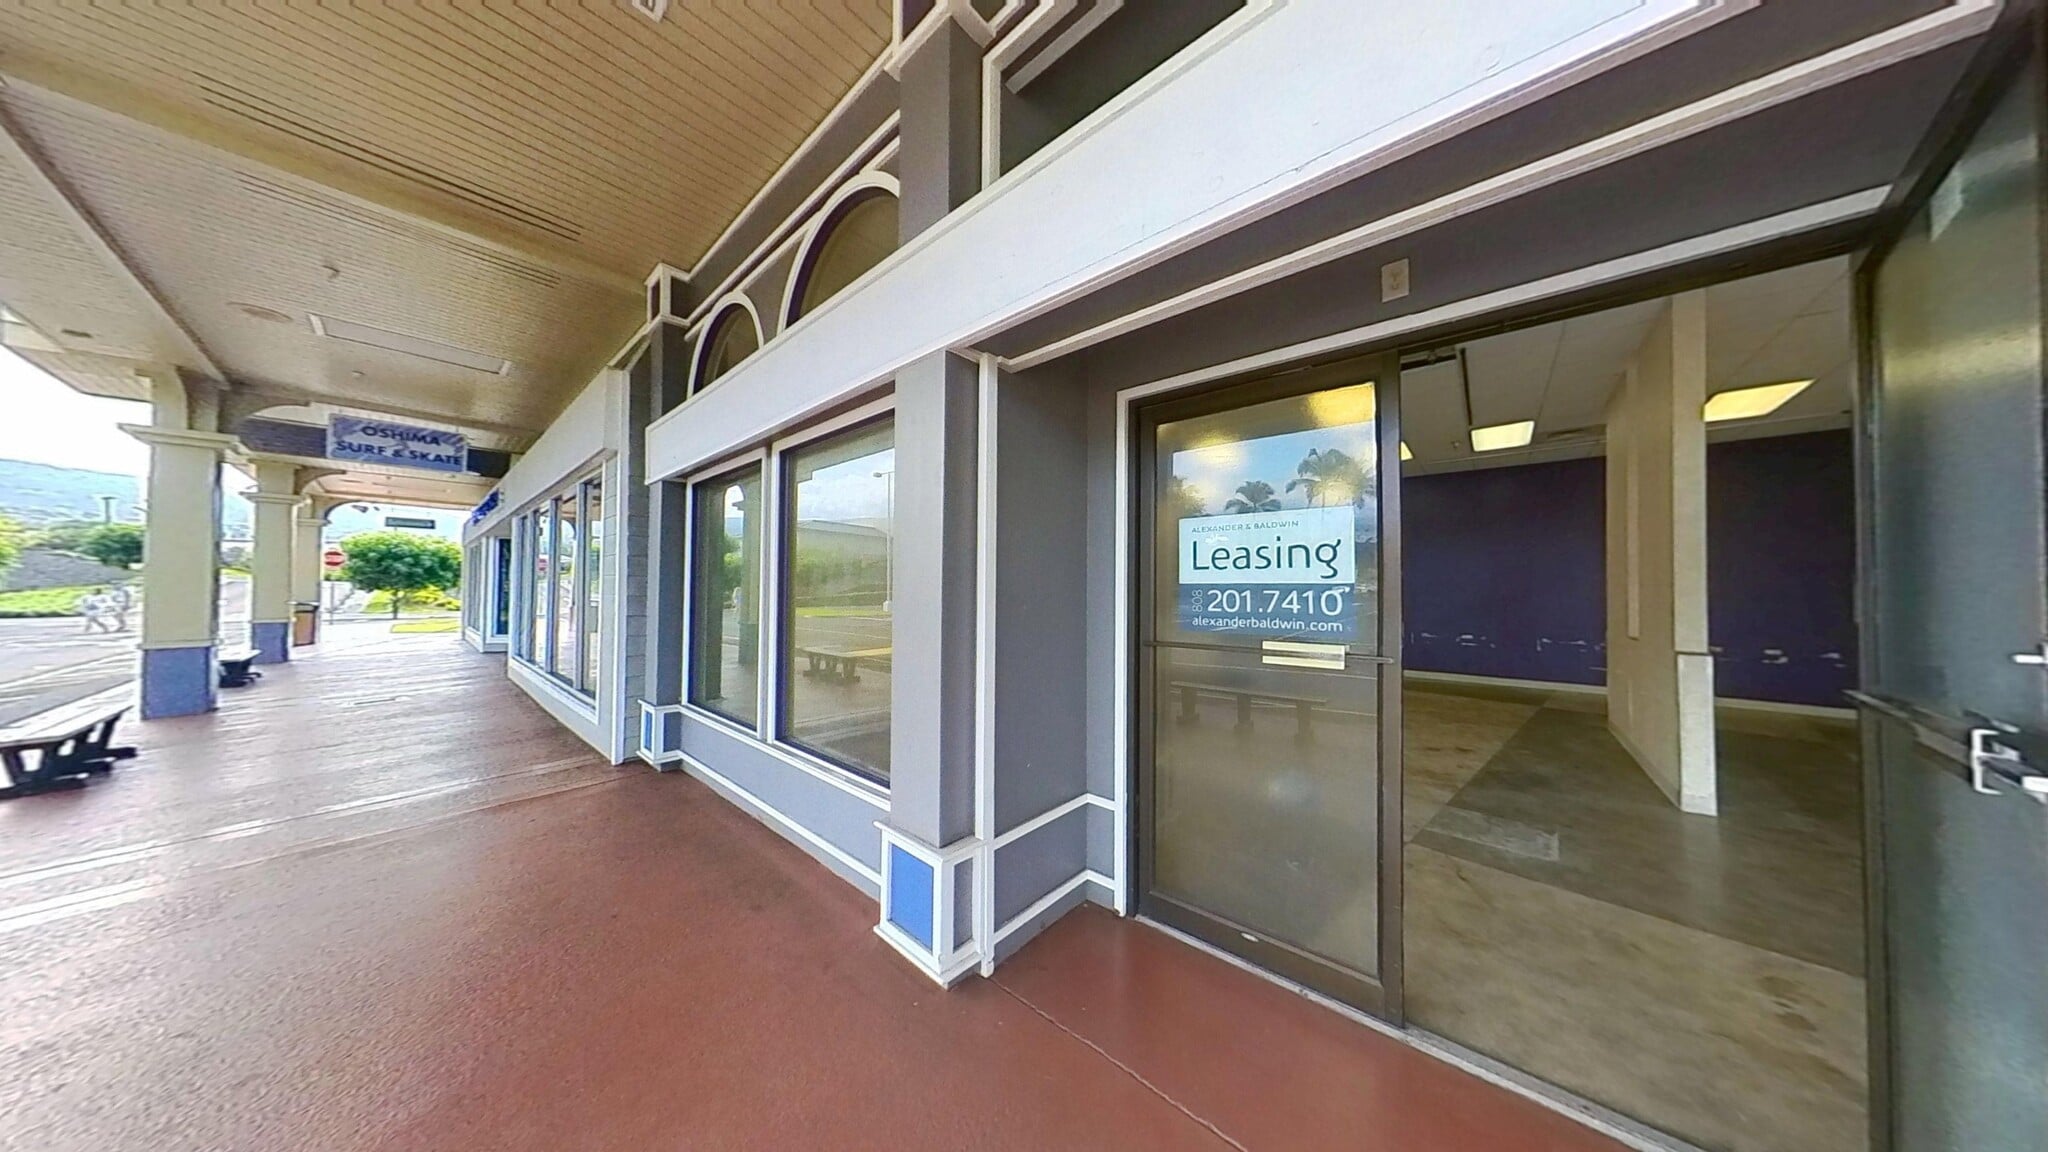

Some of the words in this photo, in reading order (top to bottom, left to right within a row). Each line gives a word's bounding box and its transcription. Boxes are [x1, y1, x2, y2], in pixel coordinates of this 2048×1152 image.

[361, 425, 441, 446] OSHIMA
[336, 440, 387, 455] SURF
[392, 448, 402, 458] &
[409, 450, 463, 465] SKATE
[1191, 523, 1244, 533] ALEXANDER
[1253, 520, 1300, 529] BALDWIN
[1192, 536, 1342, 579] Leasing
[1207, 587, 1344, 616] 201.7410
[1191, 615, 1344, 632] alexanderbaldwin.com
